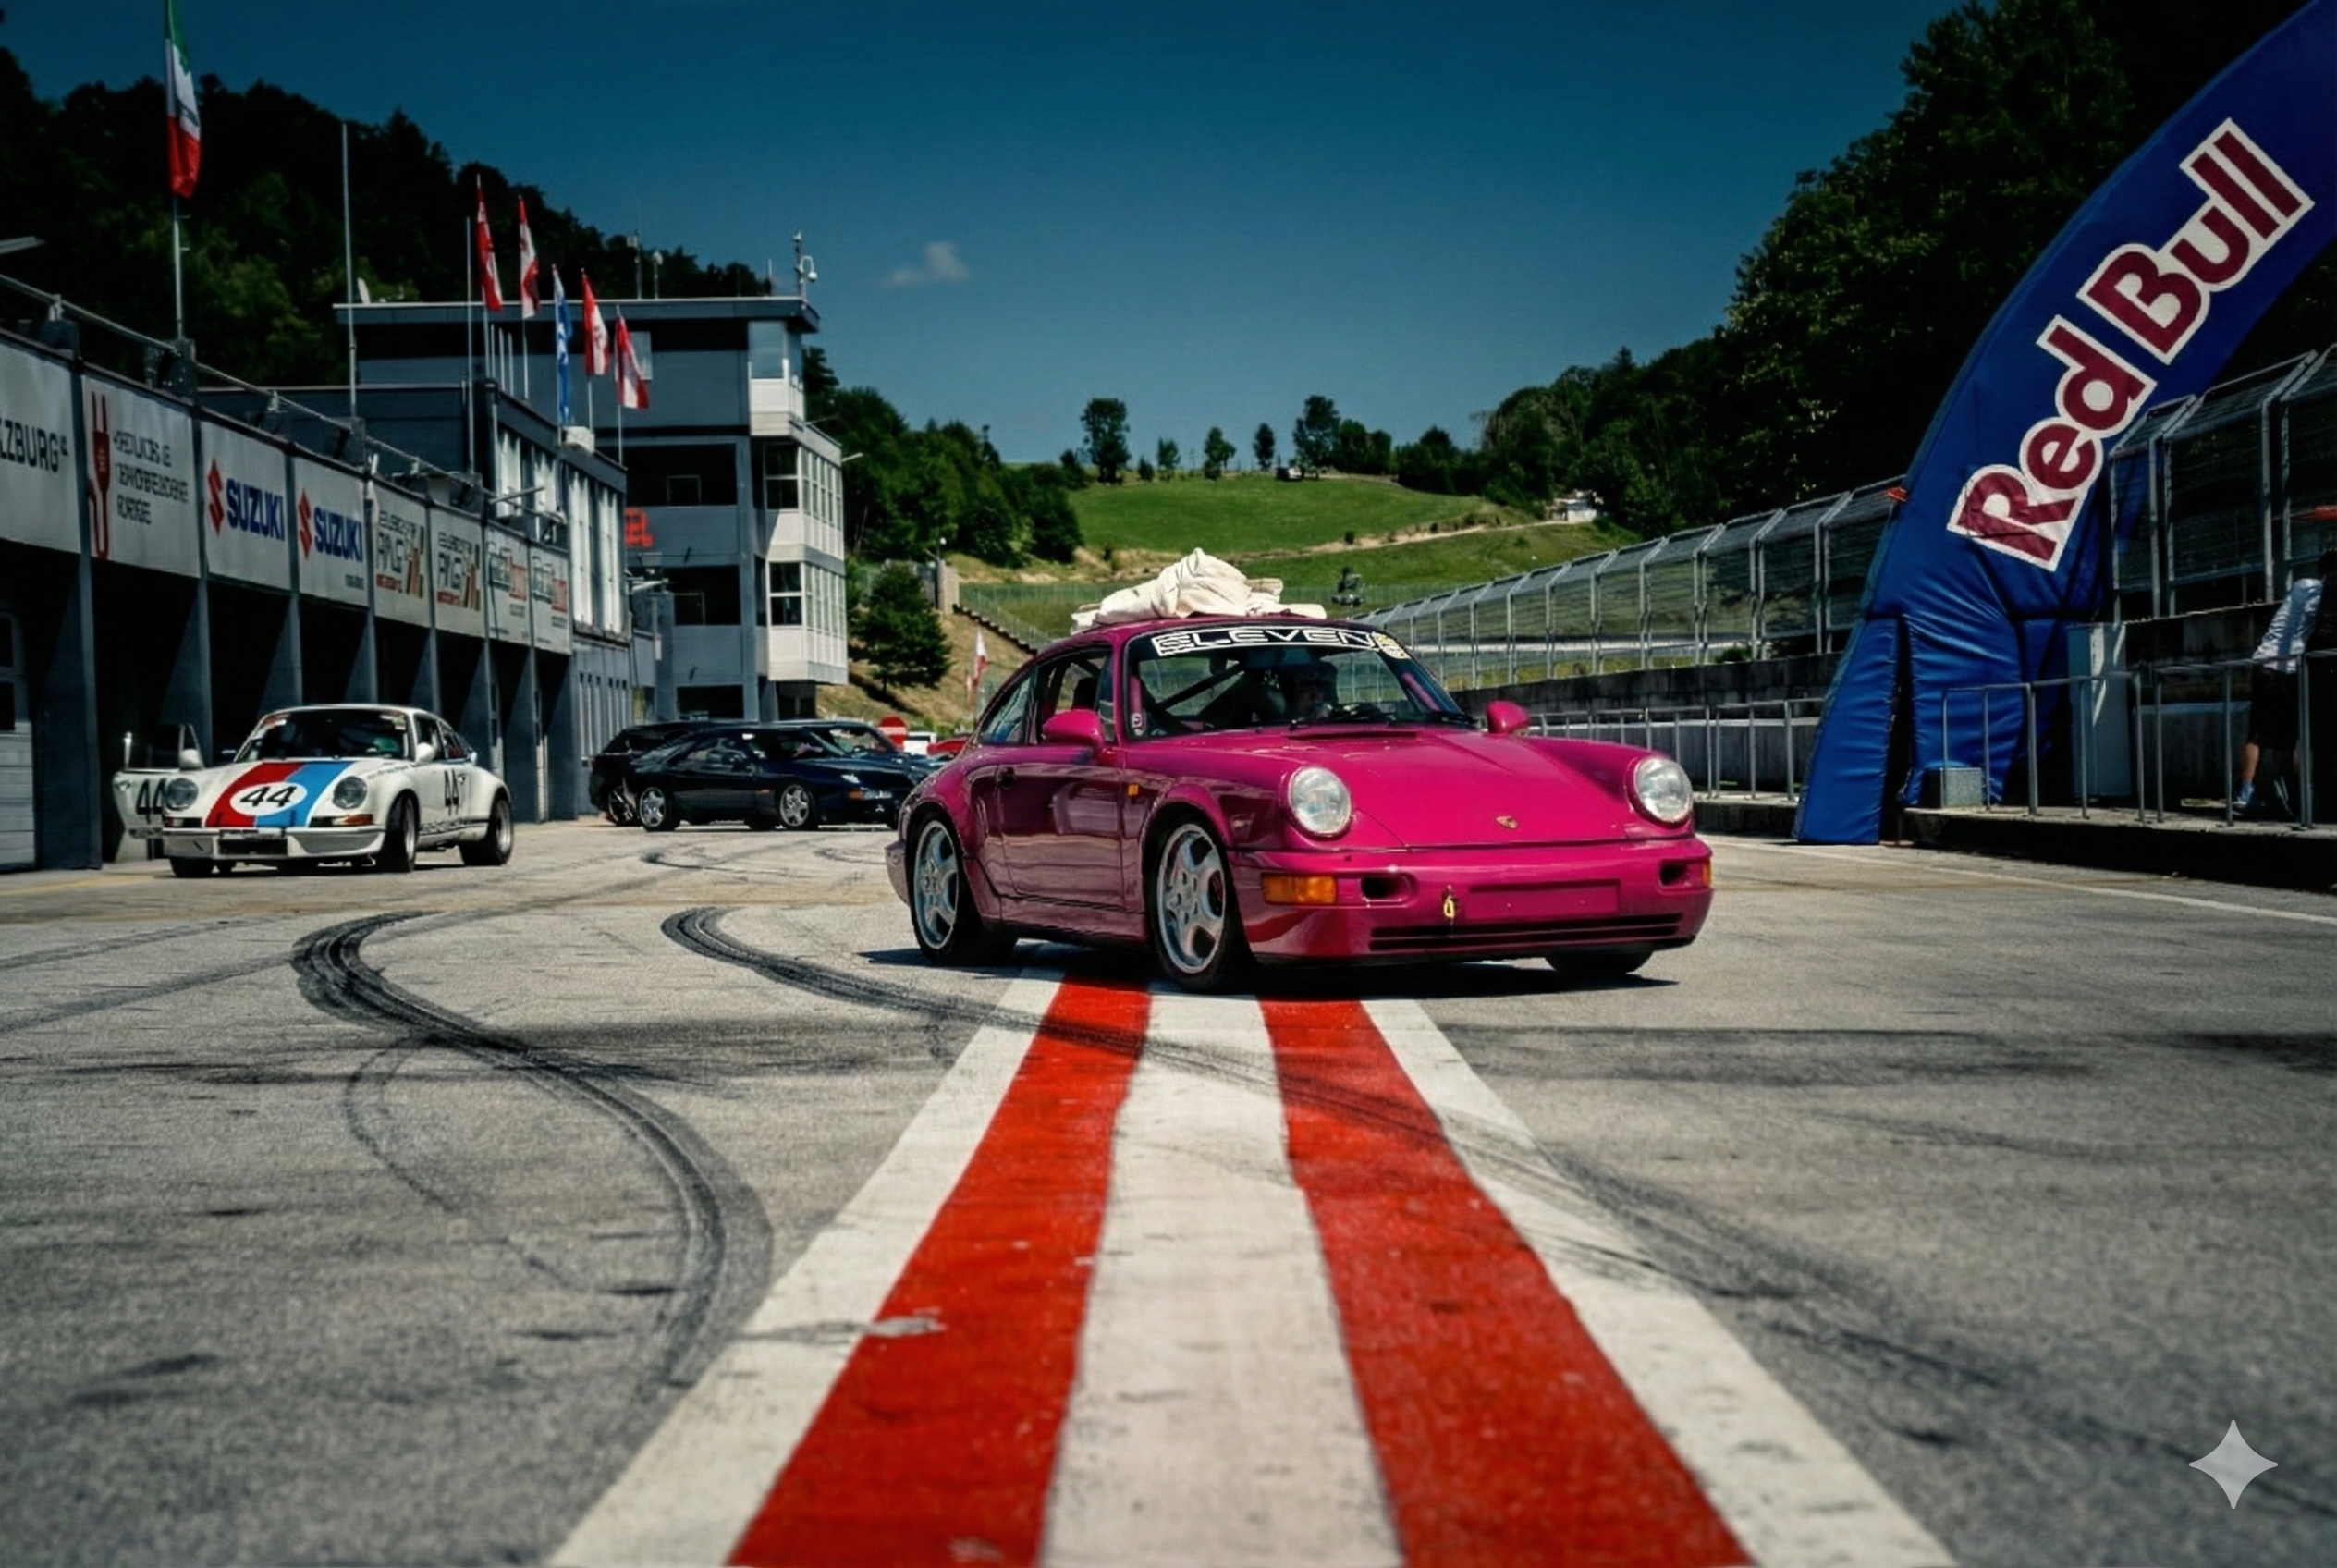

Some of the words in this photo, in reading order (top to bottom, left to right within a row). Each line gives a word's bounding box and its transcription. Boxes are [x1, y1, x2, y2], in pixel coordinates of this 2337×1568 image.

[1949, 316, 2156, 570] Red
[2078, 119, 2313, 363] Bull
[226, 477, 285, 542] SUZUKI
[314, 506, 363, 563] SUZUKI
[136, 778, 167, 825] 44
[239, 786, 298, 807] 44
[444, 769, 460, 816] 44
